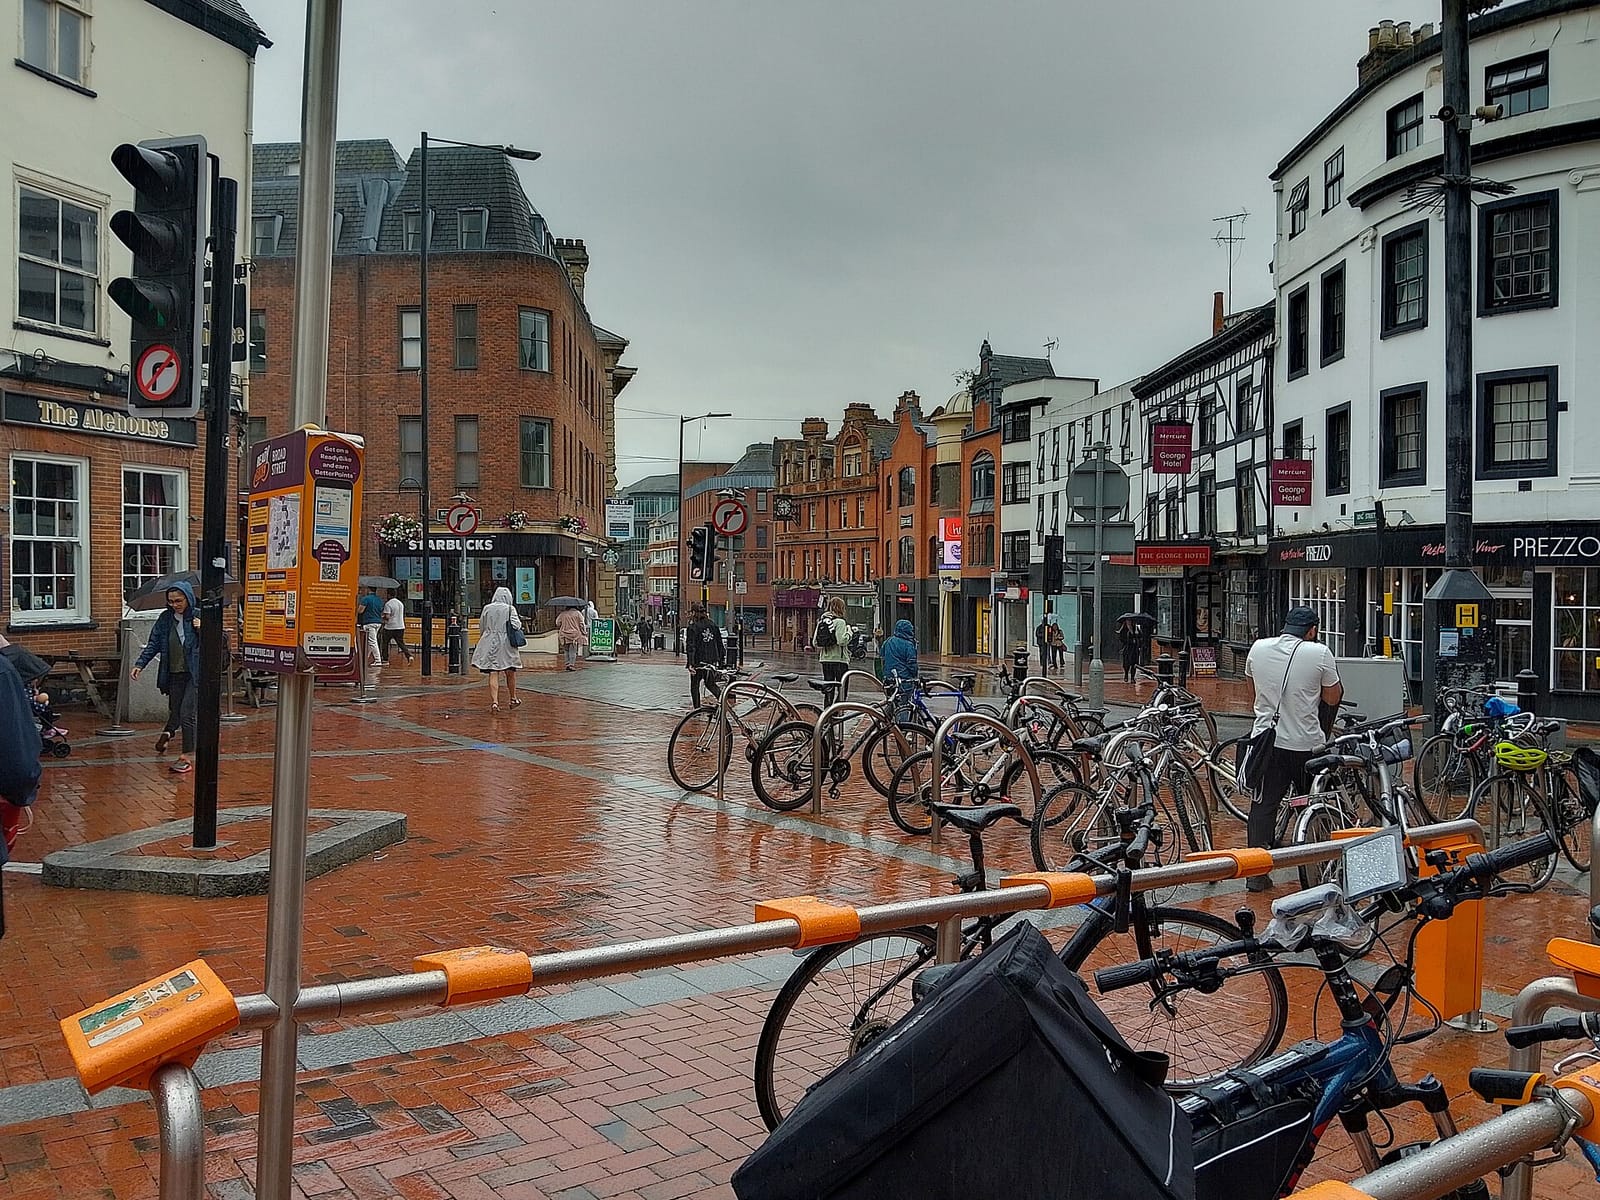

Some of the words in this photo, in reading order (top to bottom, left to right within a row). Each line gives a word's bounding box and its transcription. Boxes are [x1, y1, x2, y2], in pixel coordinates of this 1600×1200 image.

[38, 400, 79, 427] The
[82, 409, 169, 439] Alehouse
[272, 447, 287, 462] BROAD
[1160, 451, 1186, 461] George
[271, 461, 287, 476] STREET
[1278, 485, 1306, 495] George
[1281, 494, 1302, 502] Hotel
[408, 539, 494, 551] STARBUCKS
[1513, 536, 1600, 558] PREZZO
[1305, 544, 1331, 562] PREZZO
[594, 620, 609, 628] The
[594, 628, 610, 637] Bag
[591, 636, 612, 646] Shop
